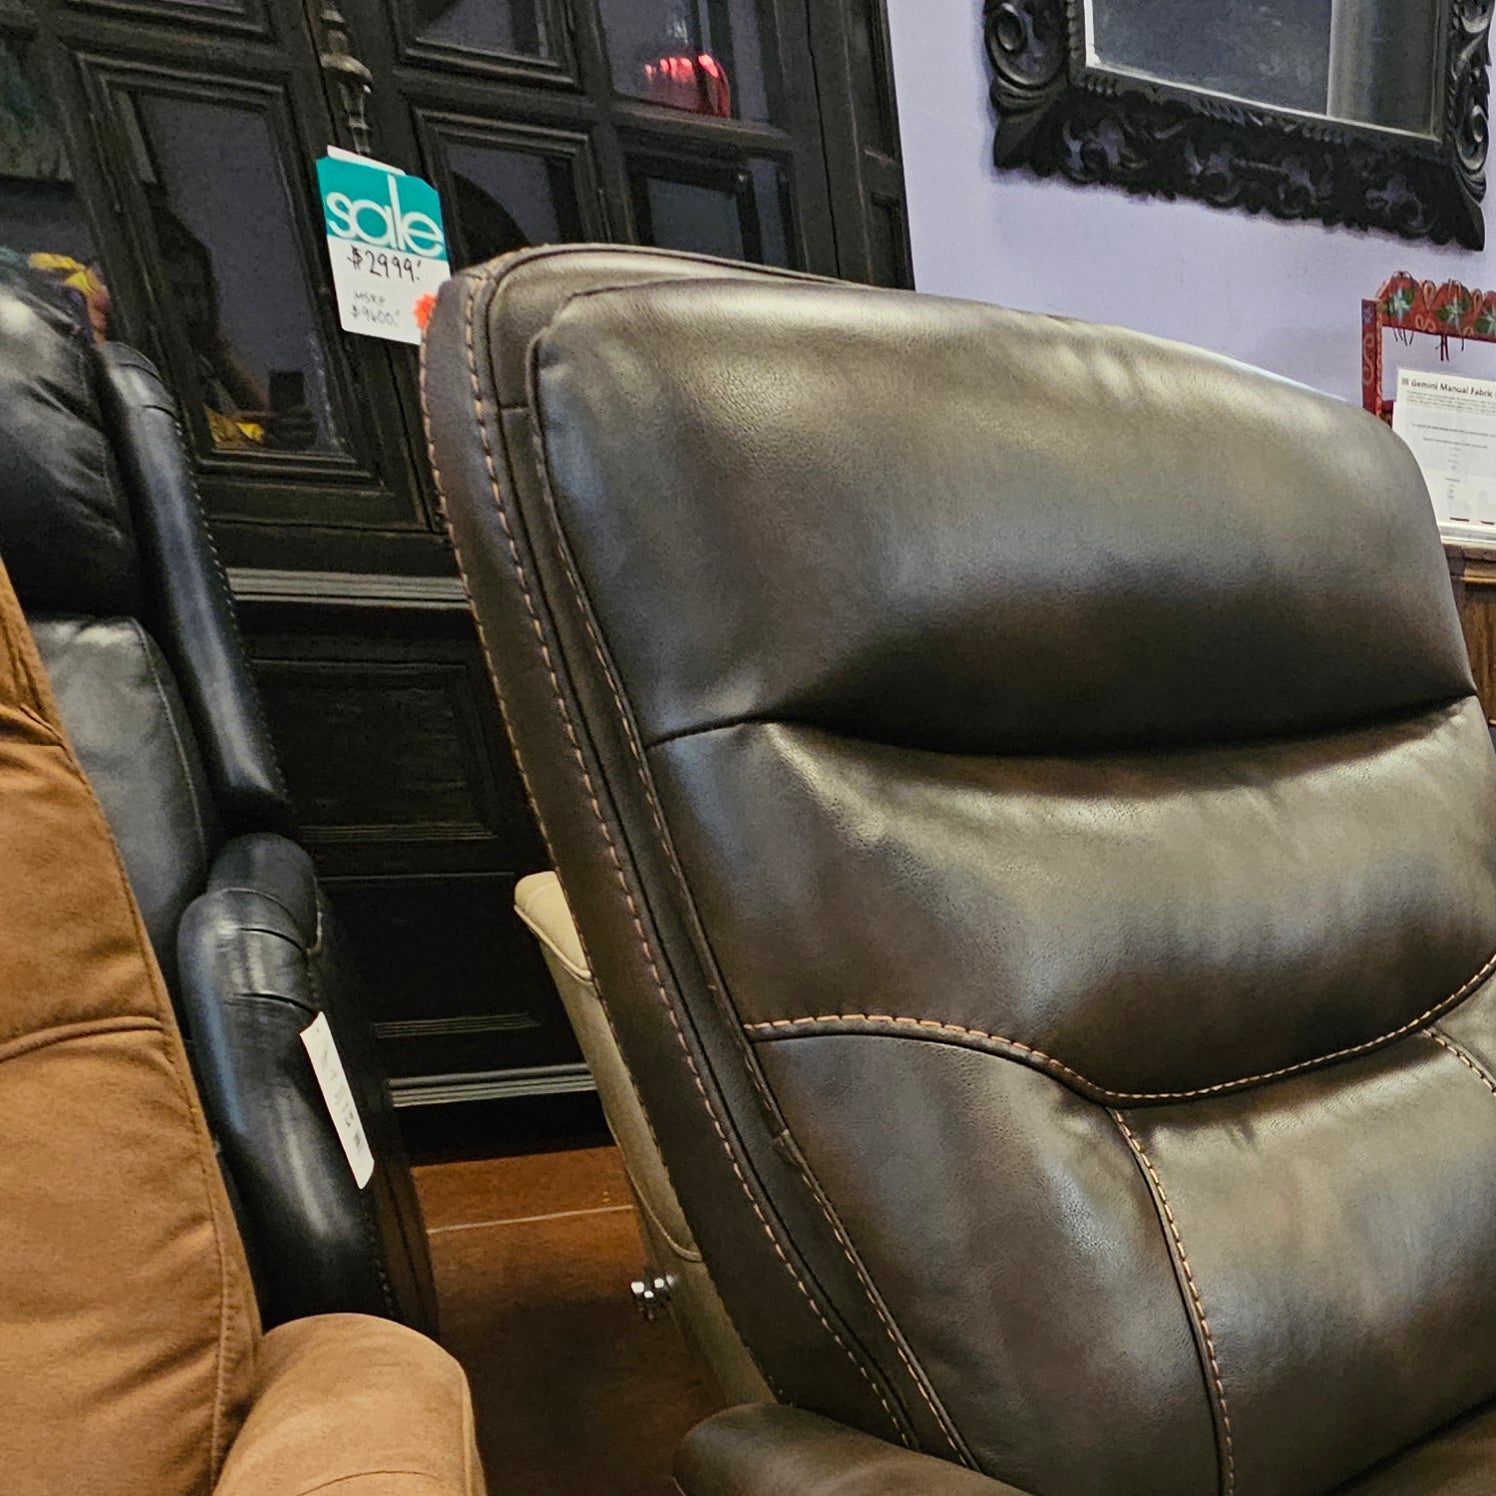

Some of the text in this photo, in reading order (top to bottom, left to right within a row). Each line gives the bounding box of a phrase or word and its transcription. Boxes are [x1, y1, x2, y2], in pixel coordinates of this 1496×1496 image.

[325, 173, 444, 257] sale
[1411, 379, 1439, 391] Gemini
[1440, 383, 1469, 395] Manual
[1470, 387, 1493, 398] Fabric
